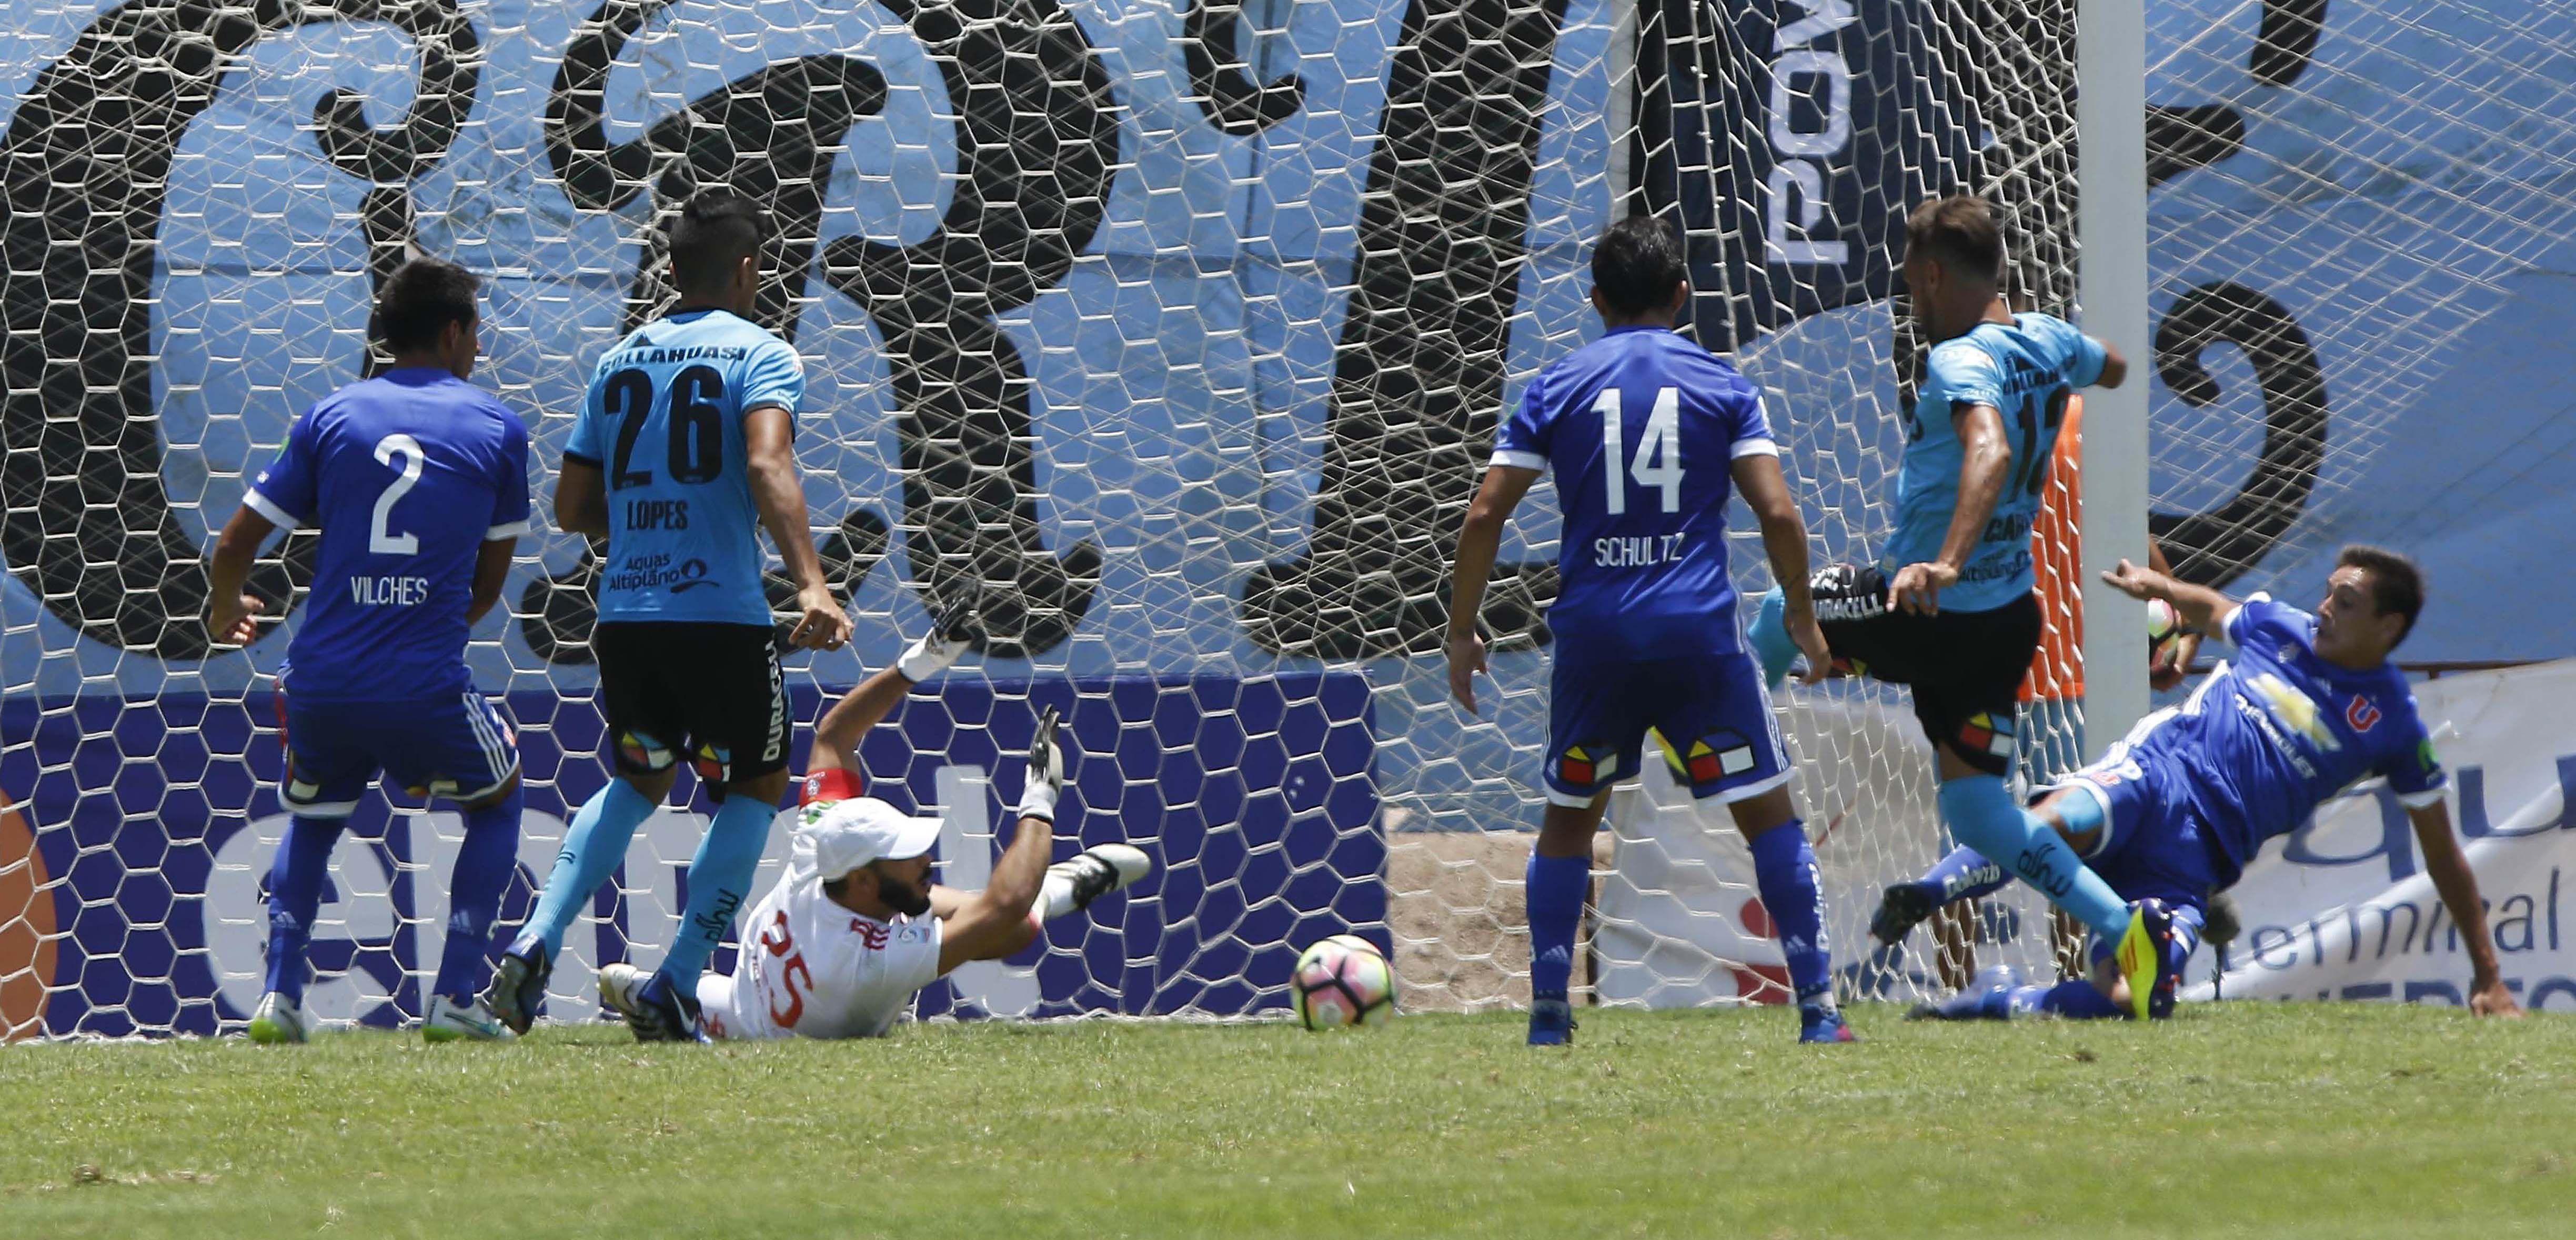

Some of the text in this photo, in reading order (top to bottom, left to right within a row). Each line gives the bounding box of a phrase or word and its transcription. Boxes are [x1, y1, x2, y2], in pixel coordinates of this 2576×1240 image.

[603, 364, 723, 491] 26
[1590, 386, 1686, 515] 14
[369, 433, 424, 556] 2
[626, 499, 689, 532] LOPES
[626, 553, 670, 572] Aguas
[1594, 532, 1685, 567] SCHULTZ
[350, 576, 429, 606] VILCHES
[608, 568, 680, 593] Altiplano
[1811, 593, 1884, 621] URACELL
